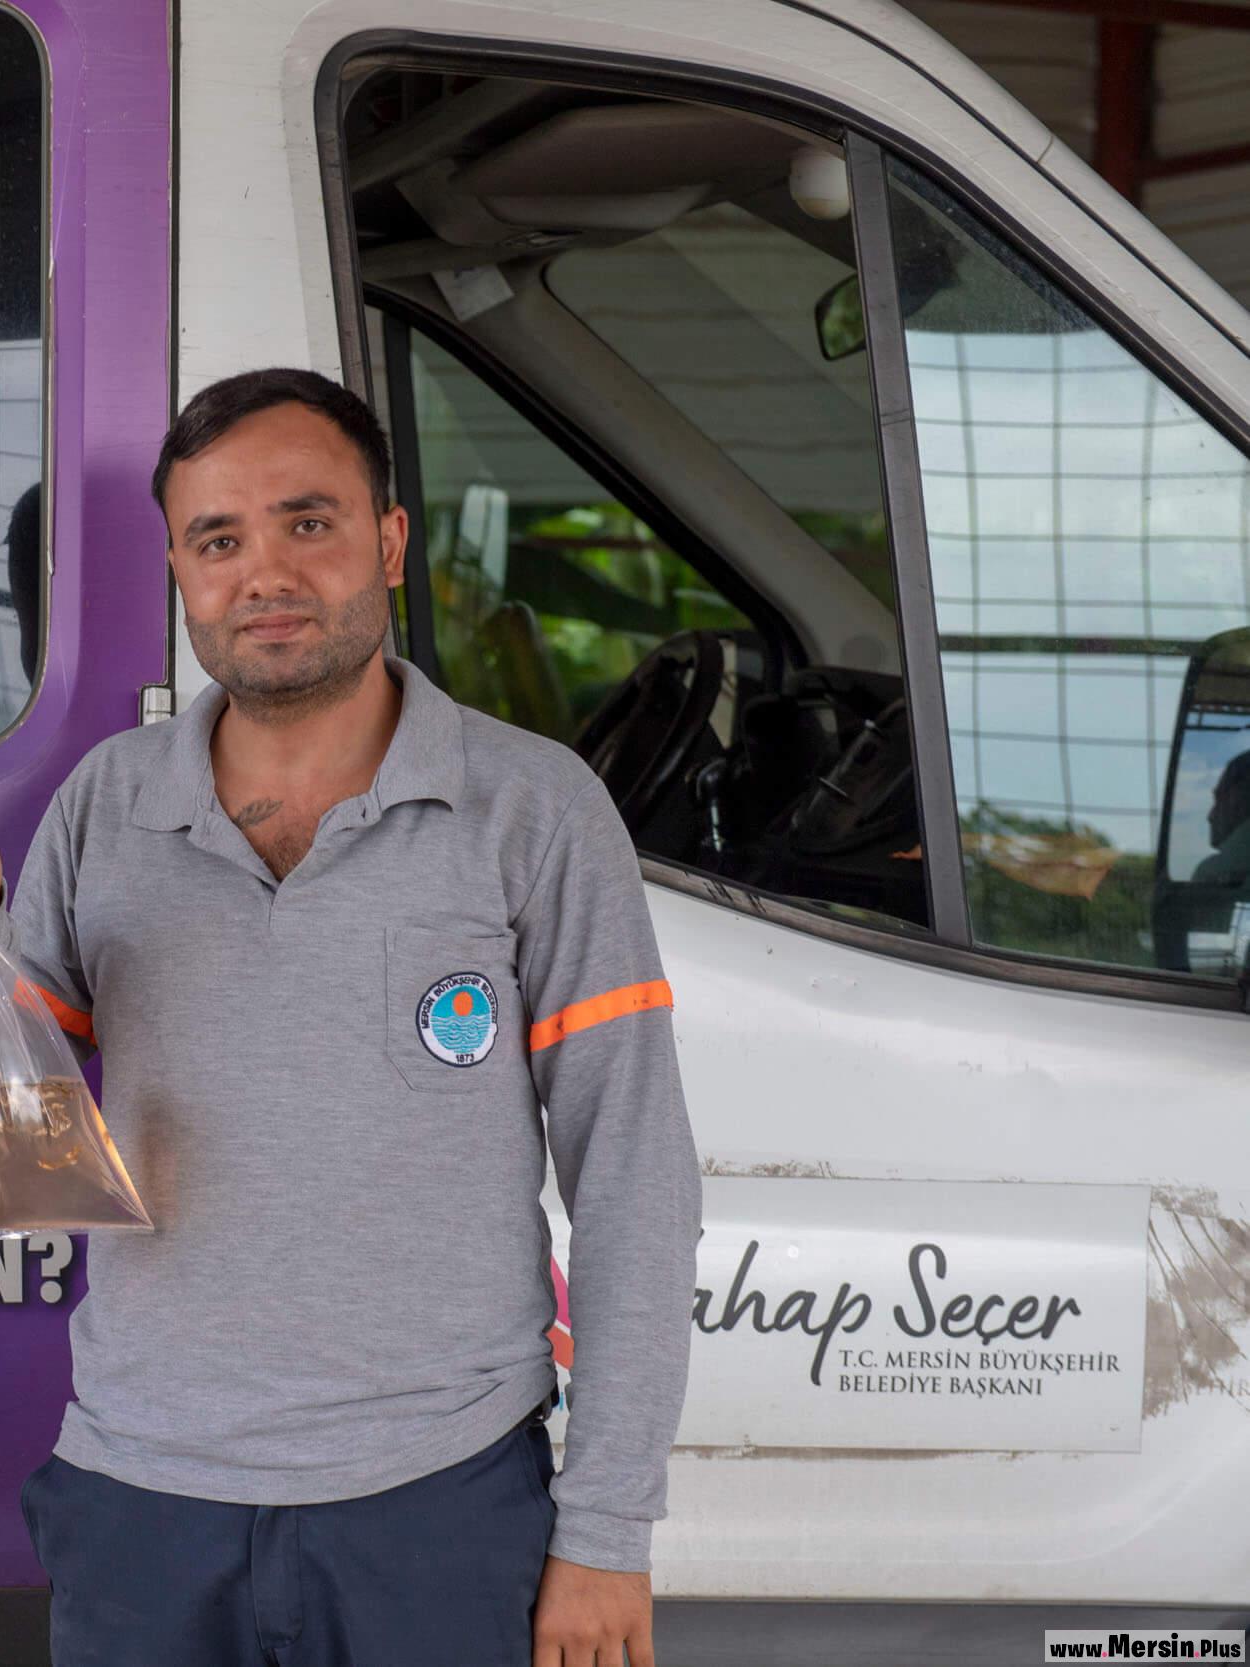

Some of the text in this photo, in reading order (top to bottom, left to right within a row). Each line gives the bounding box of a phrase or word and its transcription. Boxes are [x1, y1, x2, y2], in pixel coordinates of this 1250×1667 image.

[456, 1053, 475, 1063] 1873
[691, 1228, 1081, 1386] ahap Seçer
[839, 1347, 1120, 1376] T.C. MERSİN BÜYÜKŞEHİR
[839, 1372, 1042, 1398] BELEDİYE BAŞKANI
